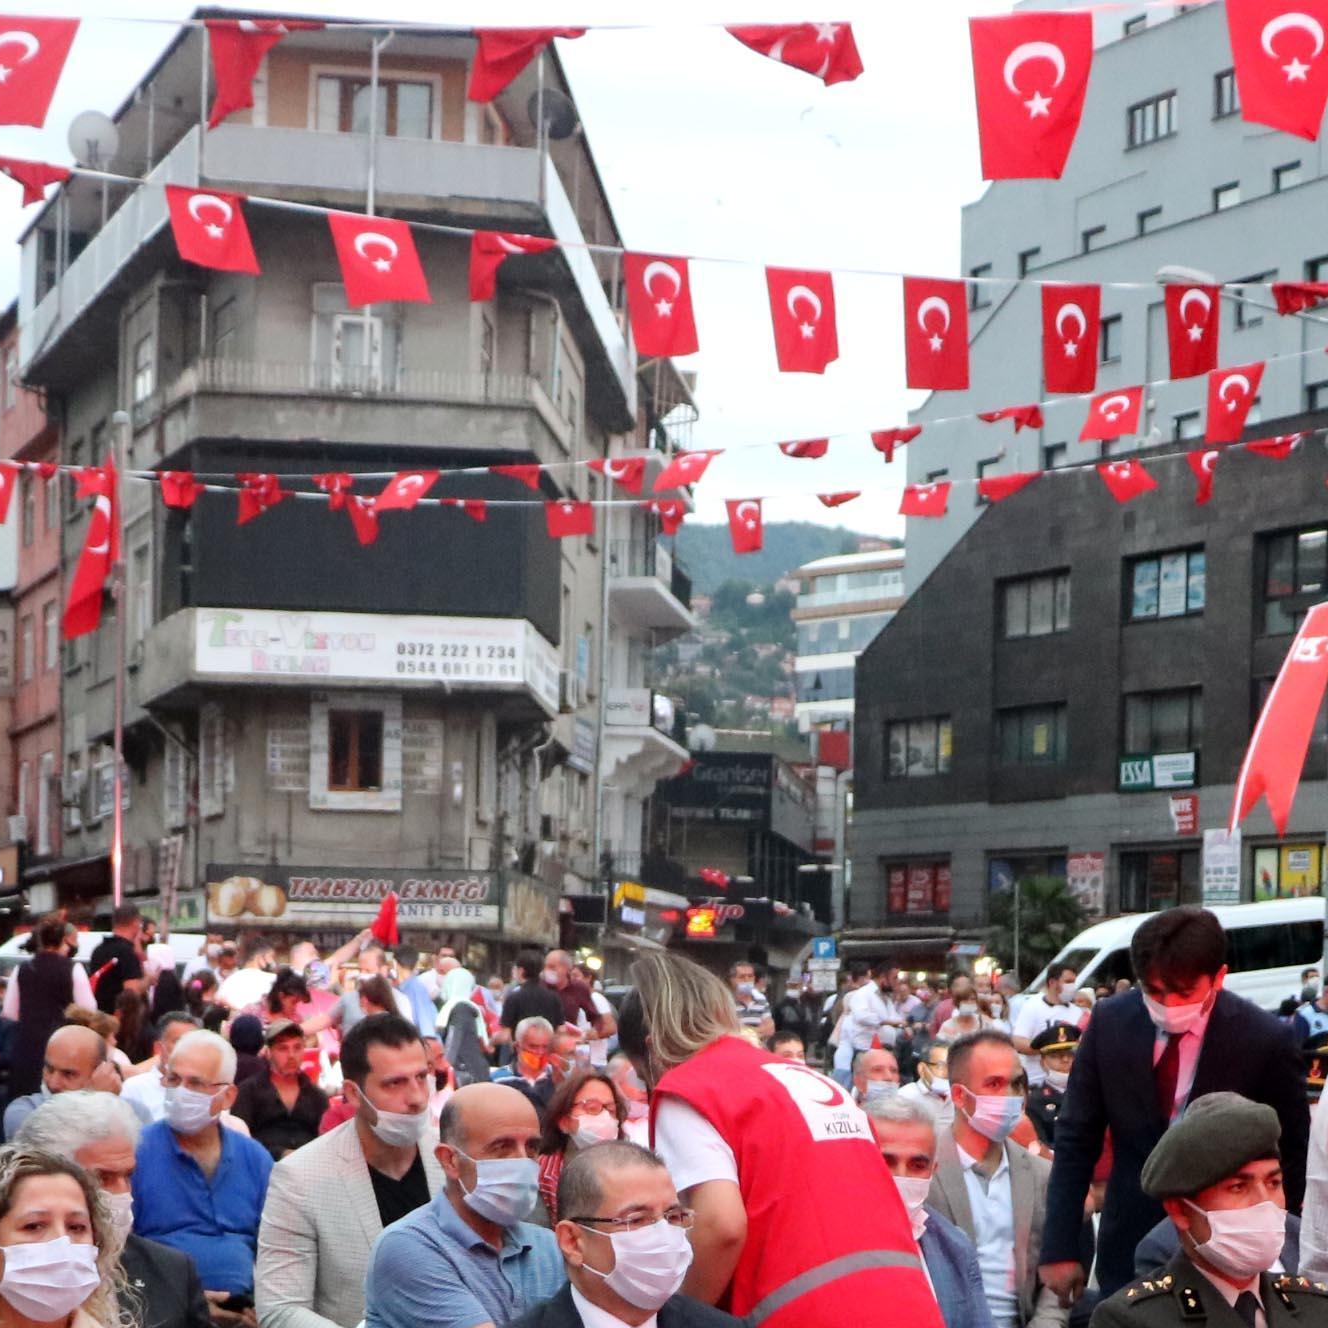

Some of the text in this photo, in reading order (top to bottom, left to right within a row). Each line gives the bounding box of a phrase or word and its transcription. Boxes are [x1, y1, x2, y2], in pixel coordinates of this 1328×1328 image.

[396, 642, 435, 656] 0372
[440, 643, 469, 657] 222
[487, 645, 516, 659] 234
[1122, 760, 1151, 785] ESSA
[289, 875, 490, 901] TRABZON EKMEĞİ
[398, 902, 438, 917] ANIT
[819, 942, 830, 955] P
[824, 1120, 862, 1136] KIZILA
